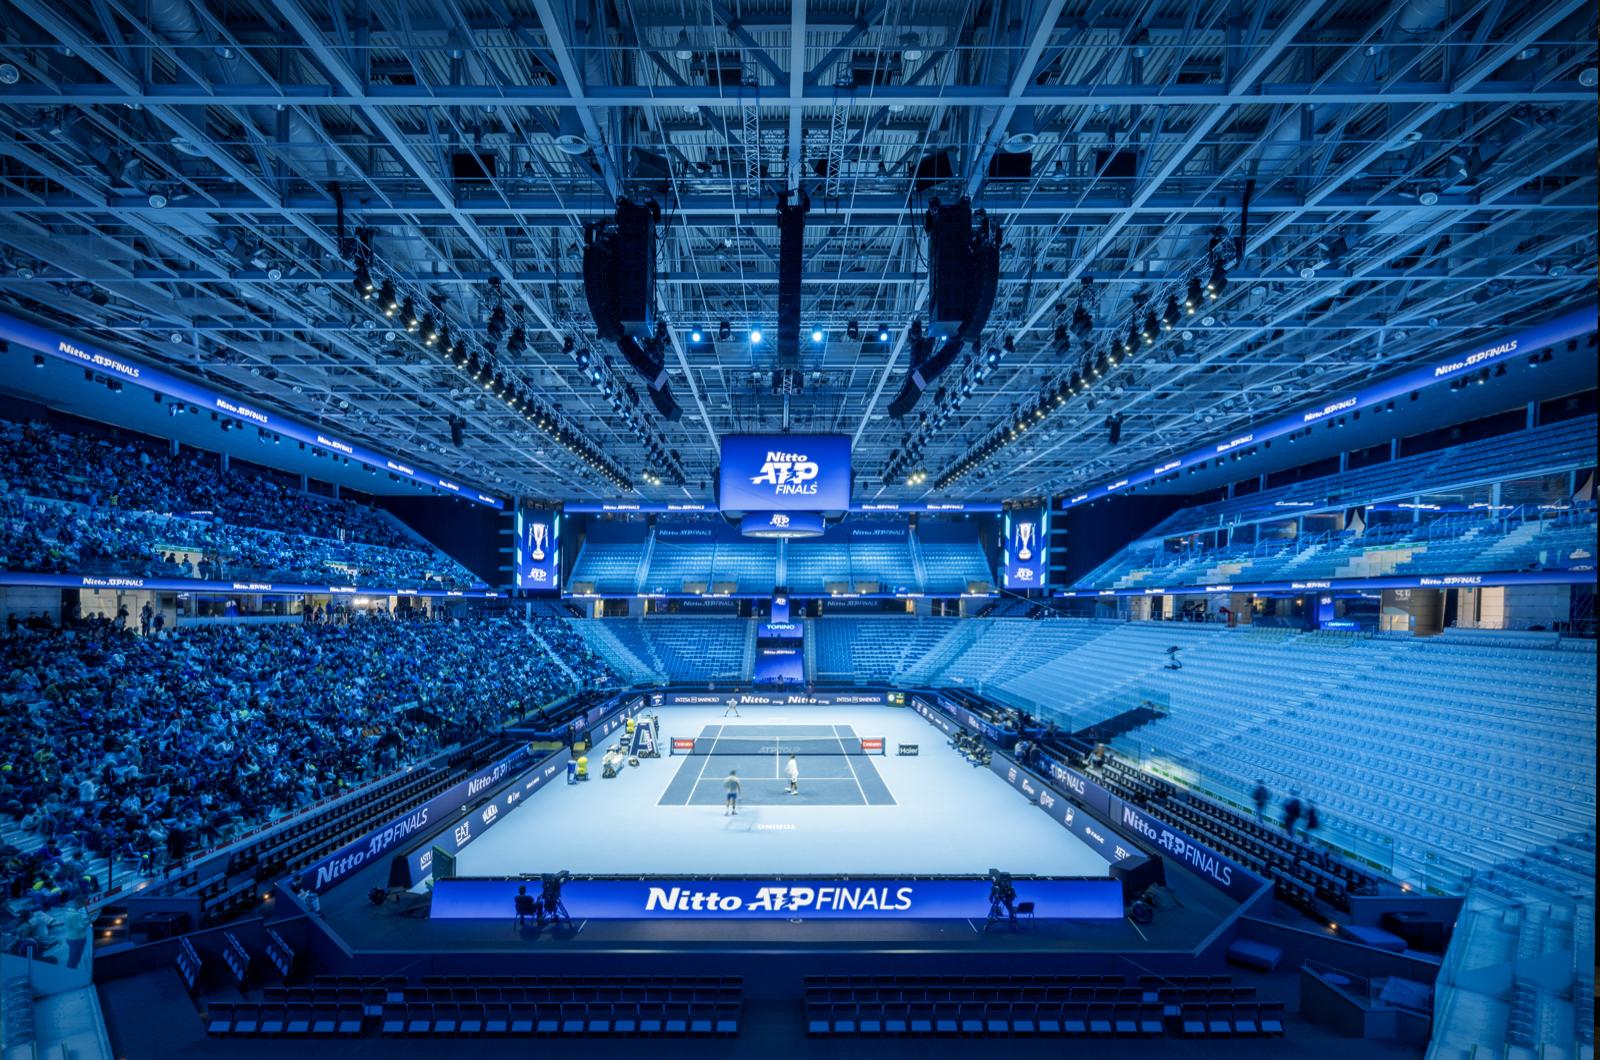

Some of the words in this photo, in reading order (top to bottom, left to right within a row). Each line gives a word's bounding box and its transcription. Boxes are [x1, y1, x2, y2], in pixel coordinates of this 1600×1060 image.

[59, 342, 91, 360] Nitto
[1435, 363, 1463, 377] Nitto
[766, 451, 808, 462] Nitto
[749, 462, 819, 485] ATP
[775, 484, 818, 495] FINALS
[740, 695, 770, 704] Nitto
[468, 776, 491, 797] Nitto
[455, 821, 469, 843] EA7
[315, 851, 364, 890] Nitto
[364, 828, 394, 859] ATP
[393, 808, 428, 843] FINALS
[1123, 806, 1157, 840] Nitto
[1158, 829, 1186, 855] ATP
[1185, 844, 1232, 886] FINALS
[644, 887, 742, 912] Nitto
[743, 887, 815, 912] ATP
[814, 887, 914, 911] FINALS
